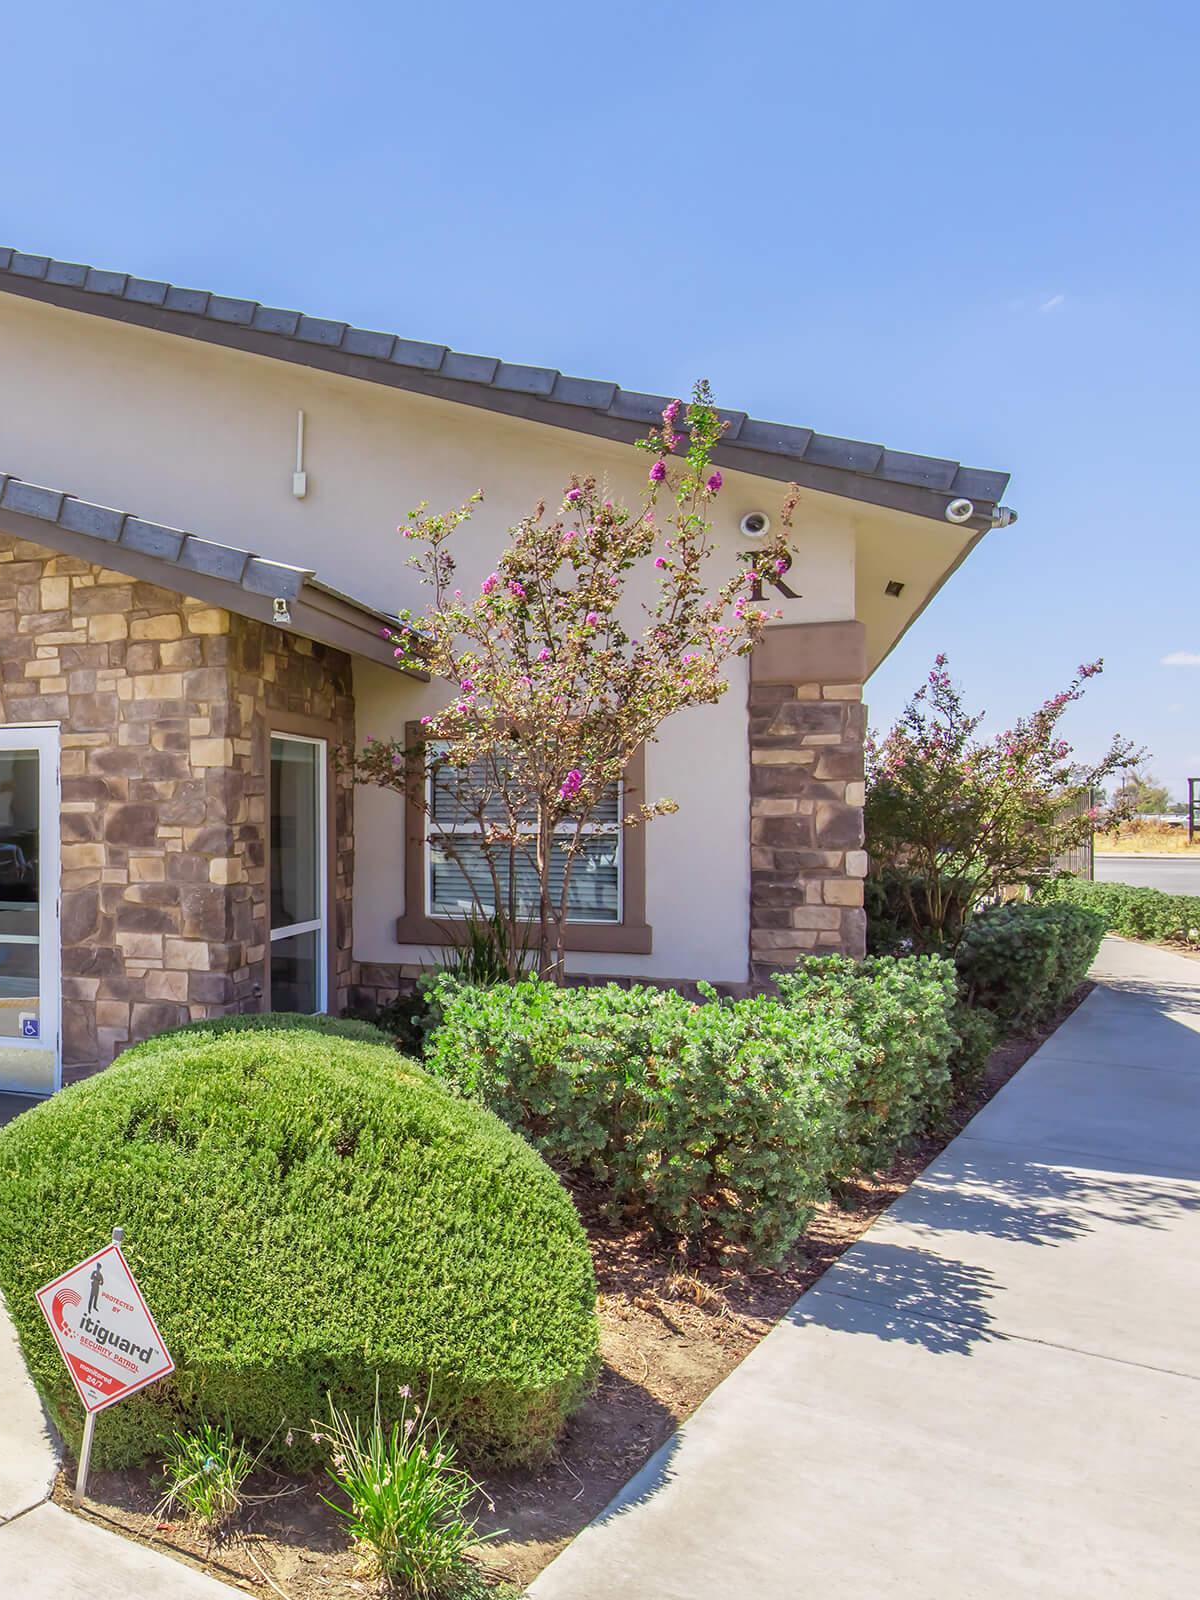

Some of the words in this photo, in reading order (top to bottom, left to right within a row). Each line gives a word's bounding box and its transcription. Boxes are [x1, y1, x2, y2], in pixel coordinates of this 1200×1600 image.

[101, 1291, 134, 1312] PROTECTED
[111, 1306, 121, 1314] BY
[79, 1335, 113, 1357] SECURITY
[113, 1353, 140, 1372] PATROL
[86, 1375, 104, 1388] 24/7
